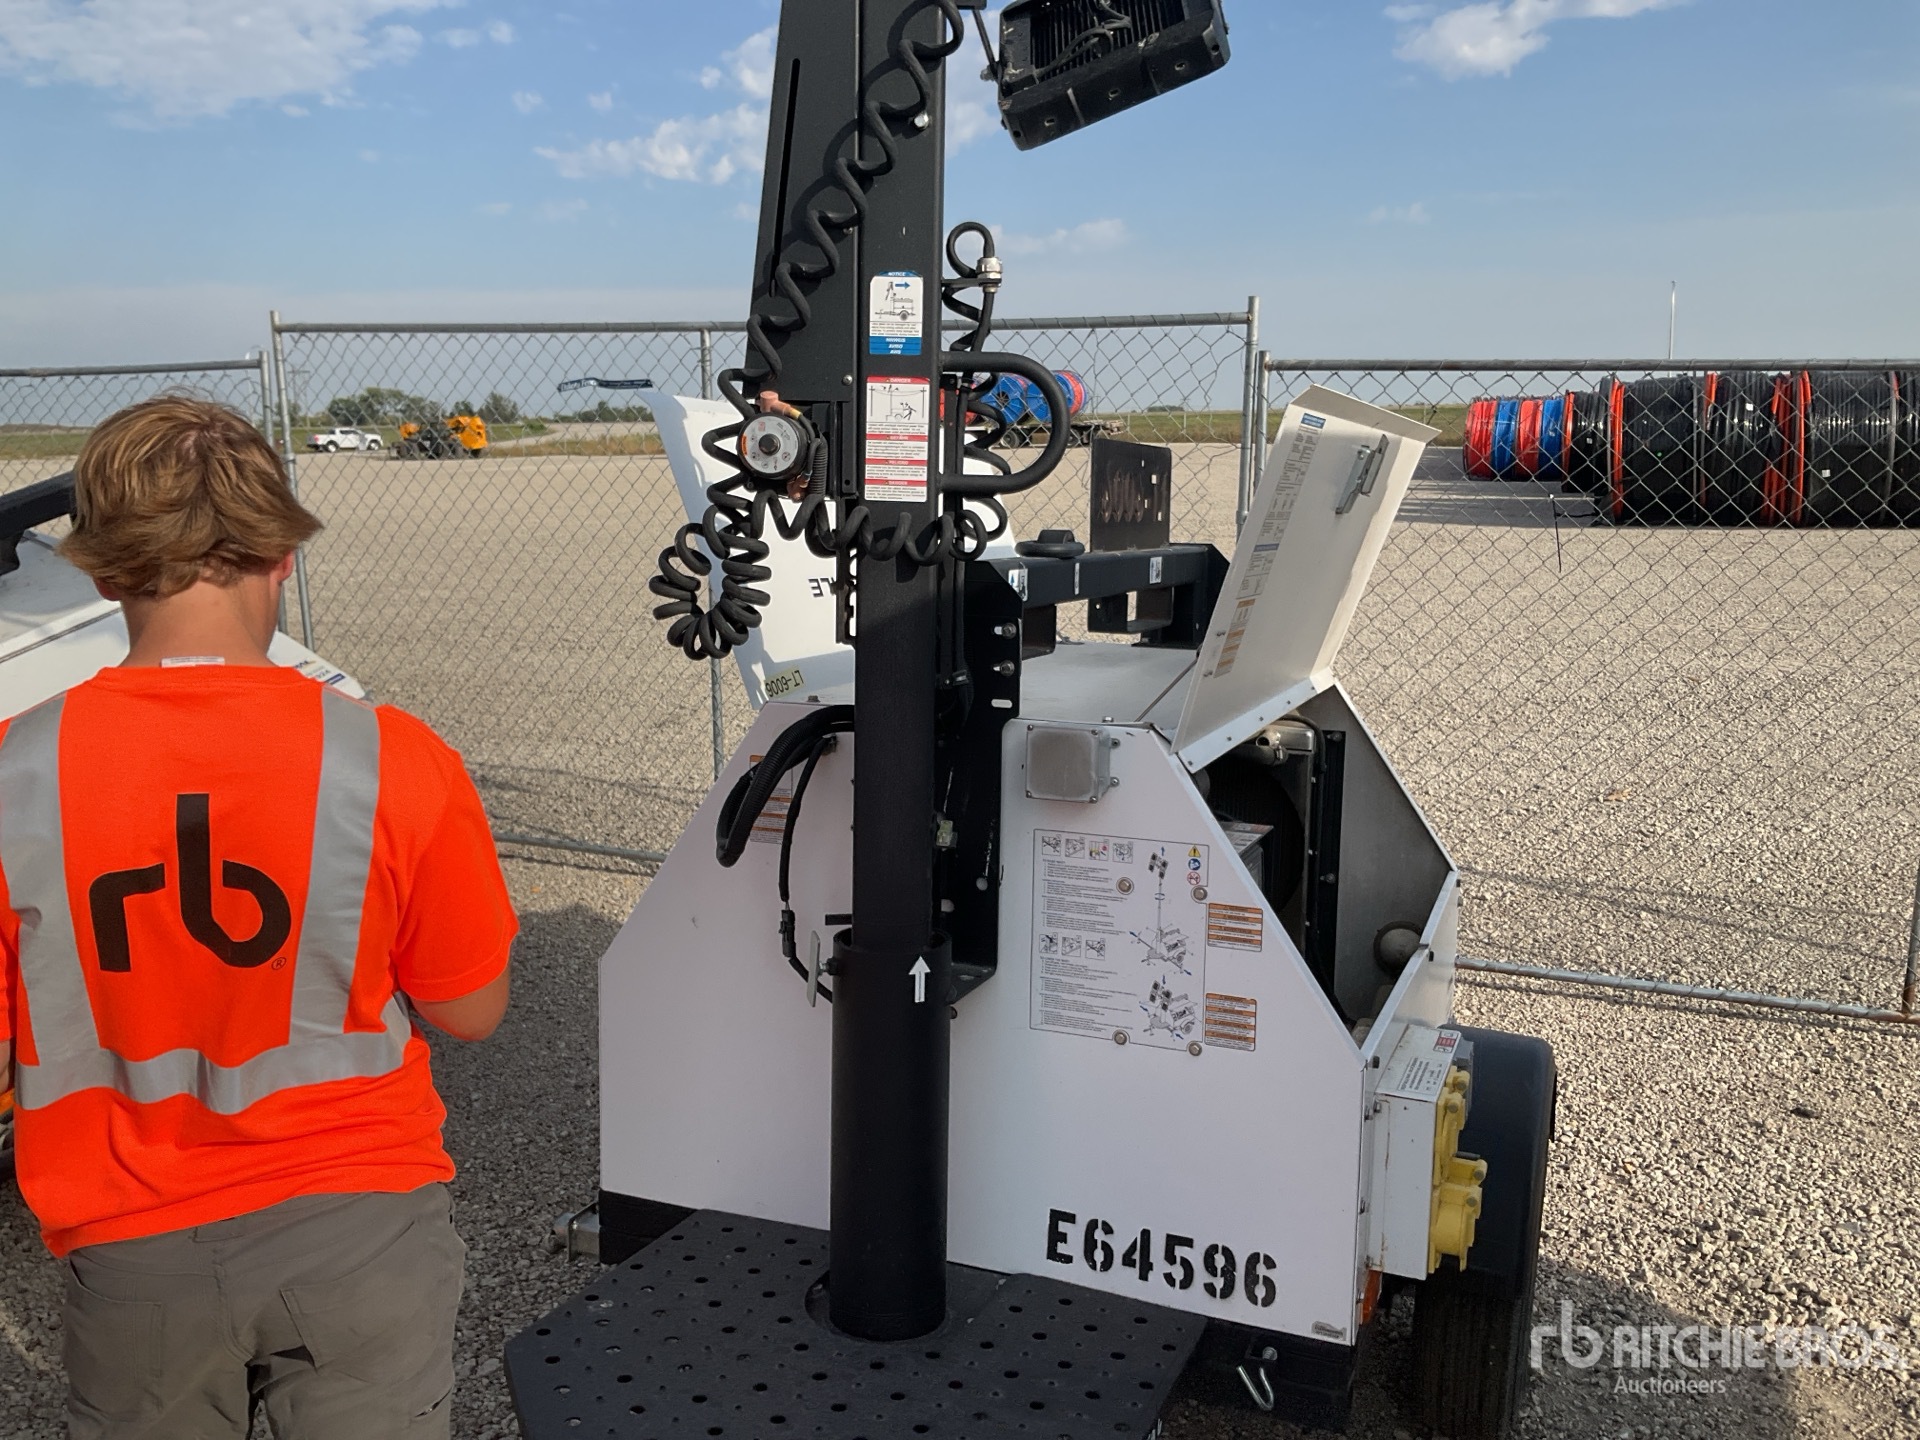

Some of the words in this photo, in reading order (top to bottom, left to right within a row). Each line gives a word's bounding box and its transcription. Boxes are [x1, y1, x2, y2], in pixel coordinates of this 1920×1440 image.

[808, 577, 837, 598] LE
[764, 669, 804, 698] LT-6006
[1046, 1208, 1277, 1308] E64596
